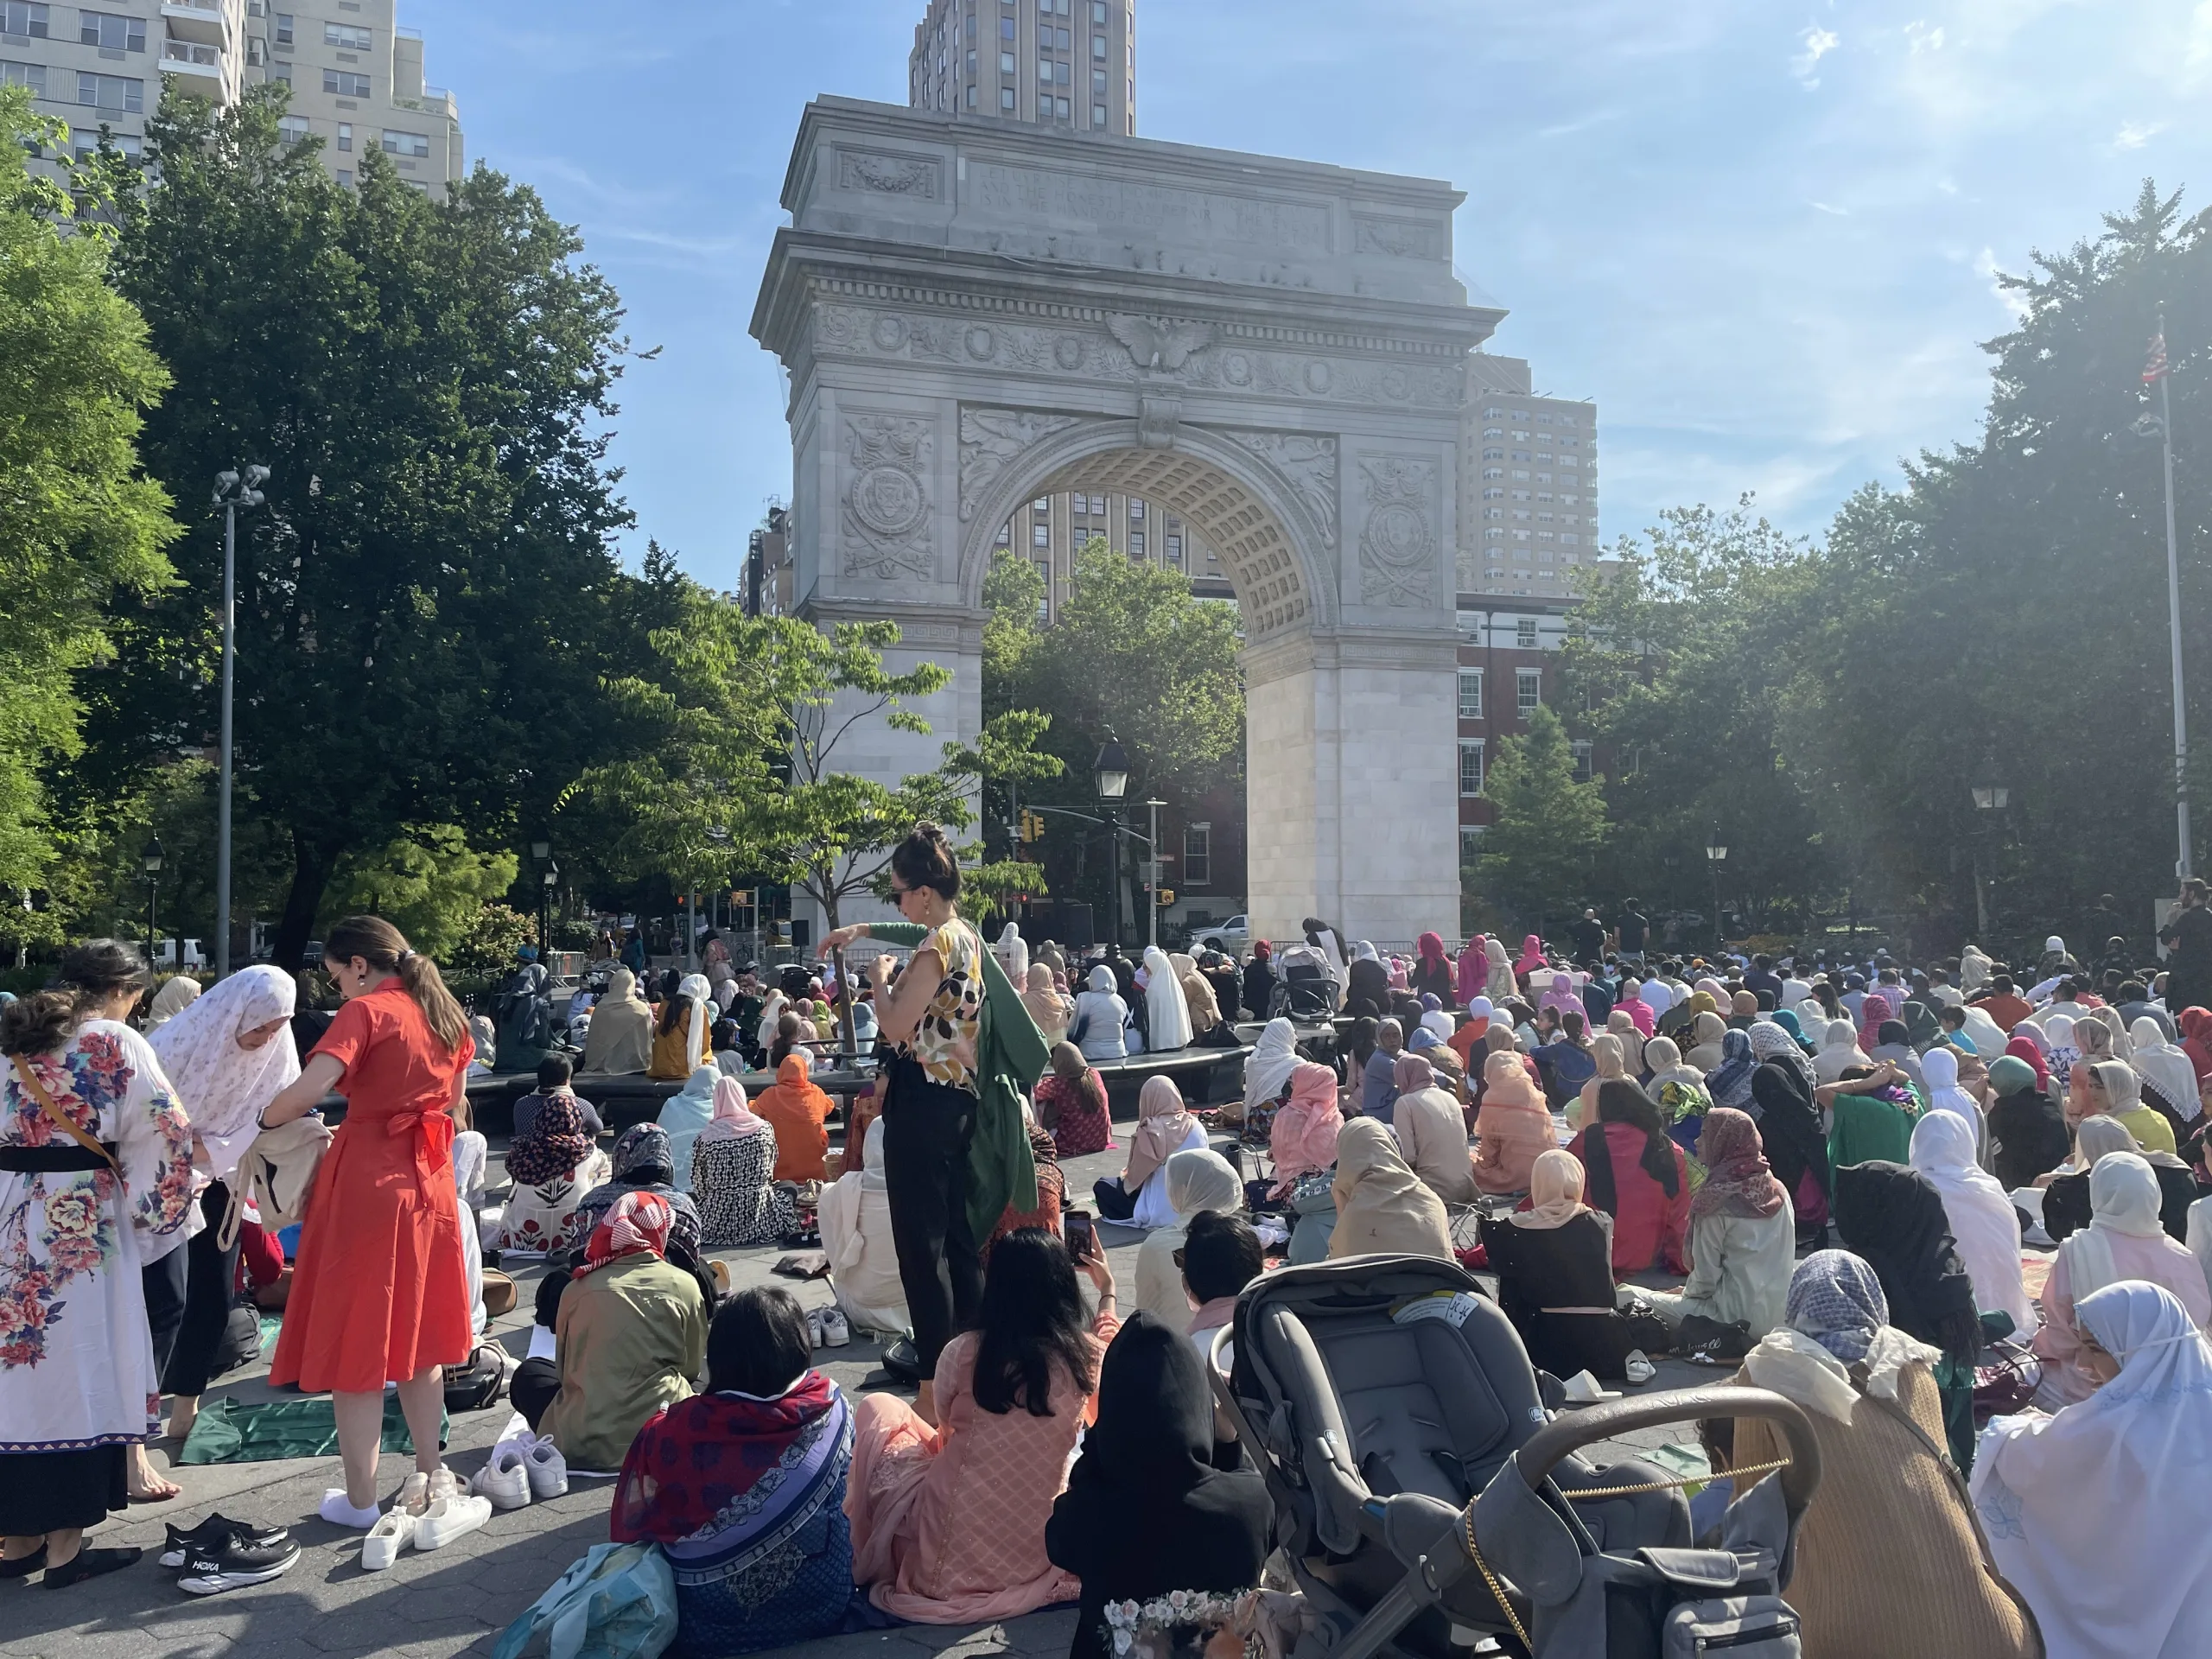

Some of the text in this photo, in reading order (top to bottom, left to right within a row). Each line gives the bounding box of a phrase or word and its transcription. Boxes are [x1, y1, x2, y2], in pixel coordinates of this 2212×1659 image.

[980, 167, 1005, 180] LET
[1255, 203, 1281, 217] THE
[980, 181, 1009, 194] AND
[1016, 184, 1046, 200] THE
[1054, 189, 1113, 208] HONEST
[1162, 204, 1211, 221] REPAIR
[1236, 213, 1263, 226] THE
[980, 192, 992, 206] IS
[998, 194, 1011, 207] IN
[1018, 197, 1048, 213] THE
[1057, 203, 1099, 219] HAND
[1106, 210, 1125, 224] OF
[192, 1560, 219, 1572] HOKA
